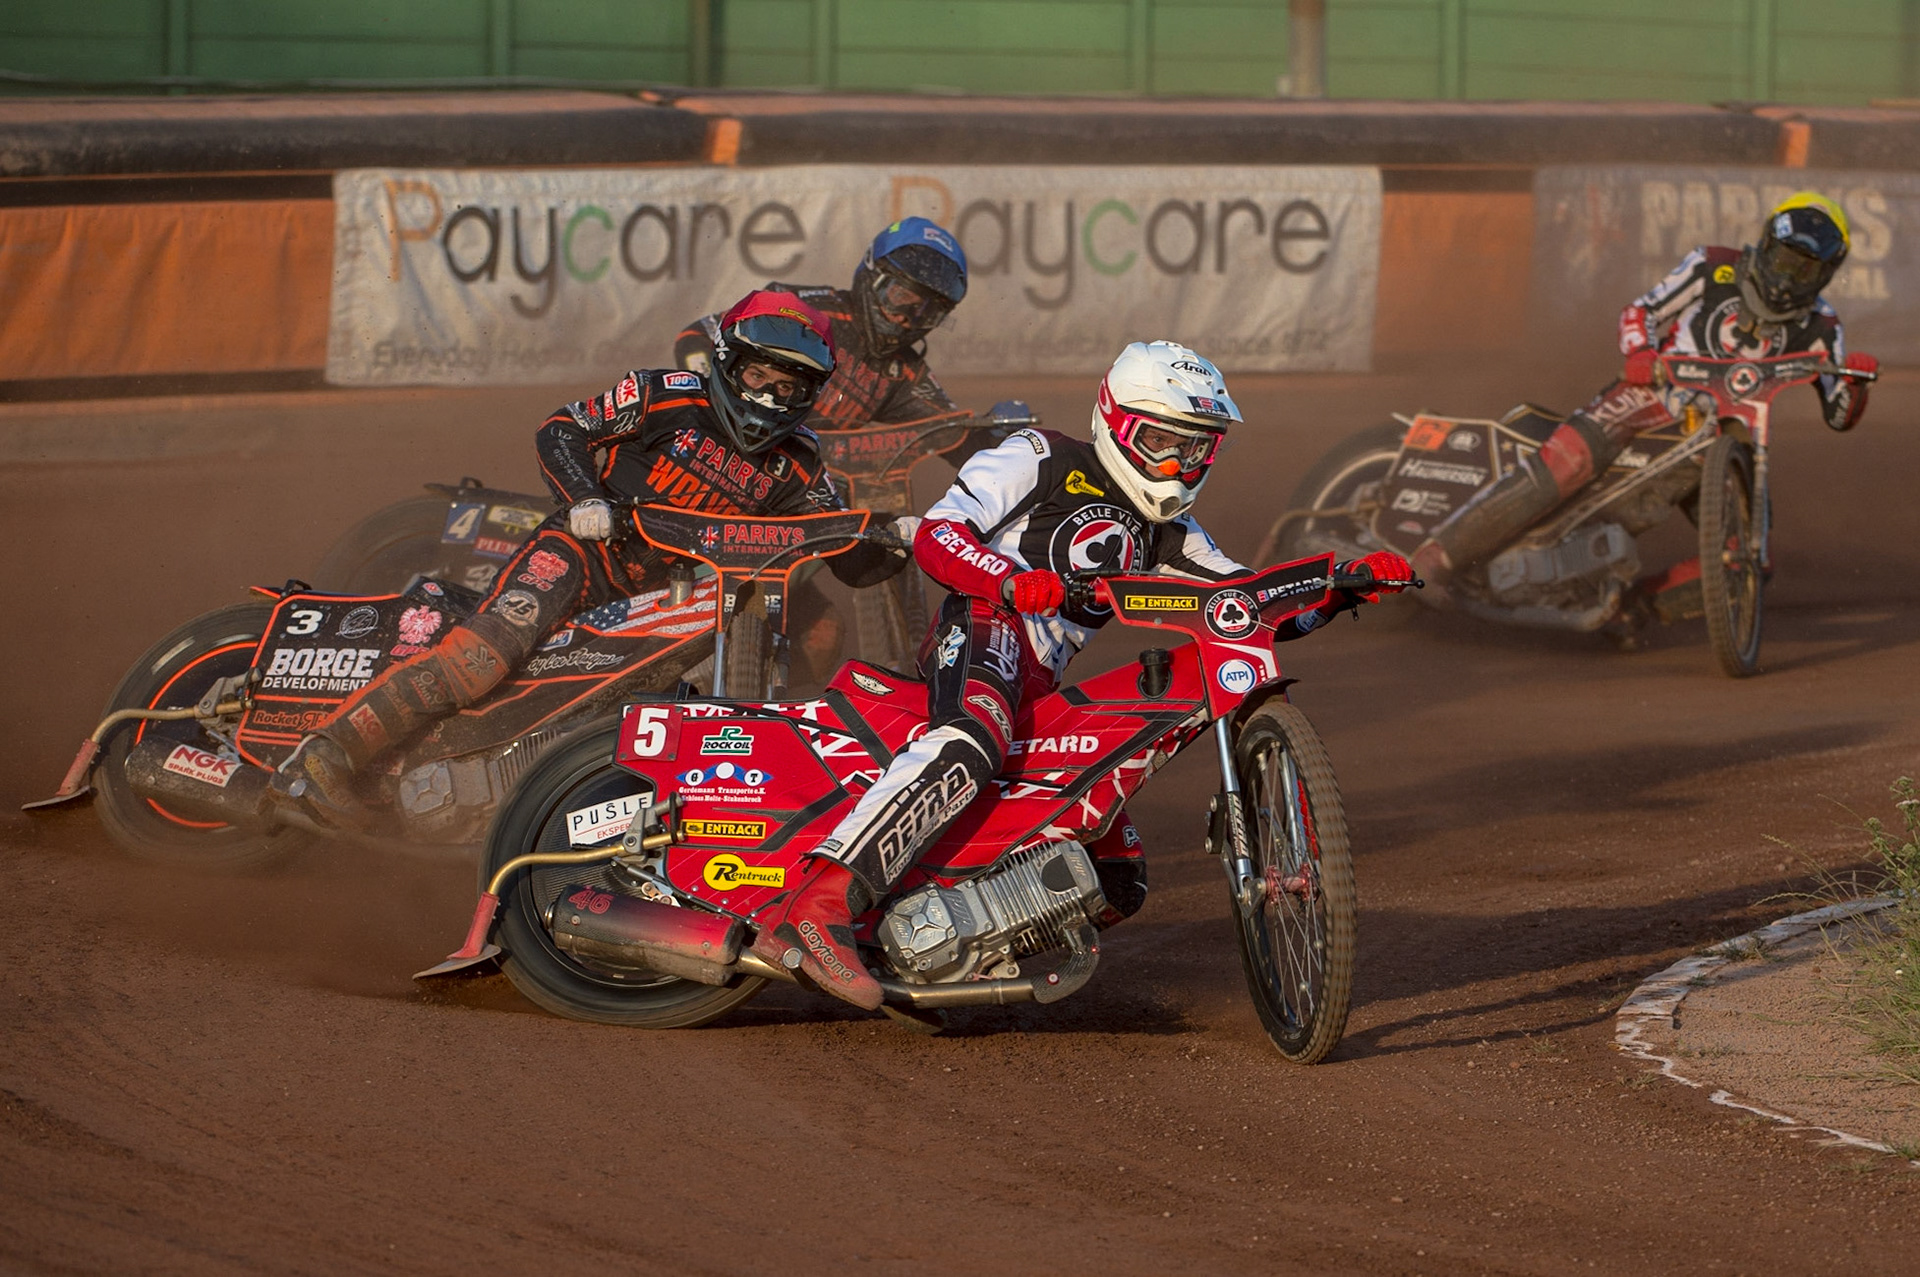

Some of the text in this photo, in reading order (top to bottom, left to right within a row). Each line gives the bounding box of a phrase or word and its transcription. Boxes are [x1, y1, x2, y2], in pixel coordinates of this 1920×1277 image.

[383, 179, 806, 319] Paycare
[891, 175, 1331, 311] Paycare
[667, 374, 698, 387] 100%
[773, 455, 787, 476] 3
[448, 508, 481, 539] 4
[1072, 508, 1112, 526] BELLE
[1118, 511, 1141, 536] VUE
[723, 524, 806, 546] PARRYS
[936, 531, 1009, 576] BETARD
[1148, 598, 1193, 609] ENTRACK
[286, 610, 324, 635] 3
[266, 648, 381, 679] BORGE
[262, 677, 371, 692] DEVELOPMENT
[1225, 670, 1249, 682] ATPI
[253, 711, 299, 726] Rocket
[633, 707, 670, 757] 5
[703, 741, 751, 750] ROCK OIL
[1007, 735, 1099, 756] ETARD
[172, 747, 236, 776] NGK
[168, 762, 225, 785] SPARK PLUGS
[750, 773, 758, 783] T
[718, 787, 754, 795] Transporte
[943, 789, 976, 818] Parts
[706, 824, 760, 836] ENTRACK
[713, 862, 782, 882] Rentruck
[569, 886, 615, 914] 46
[799, 921, 858, 982] daytona
